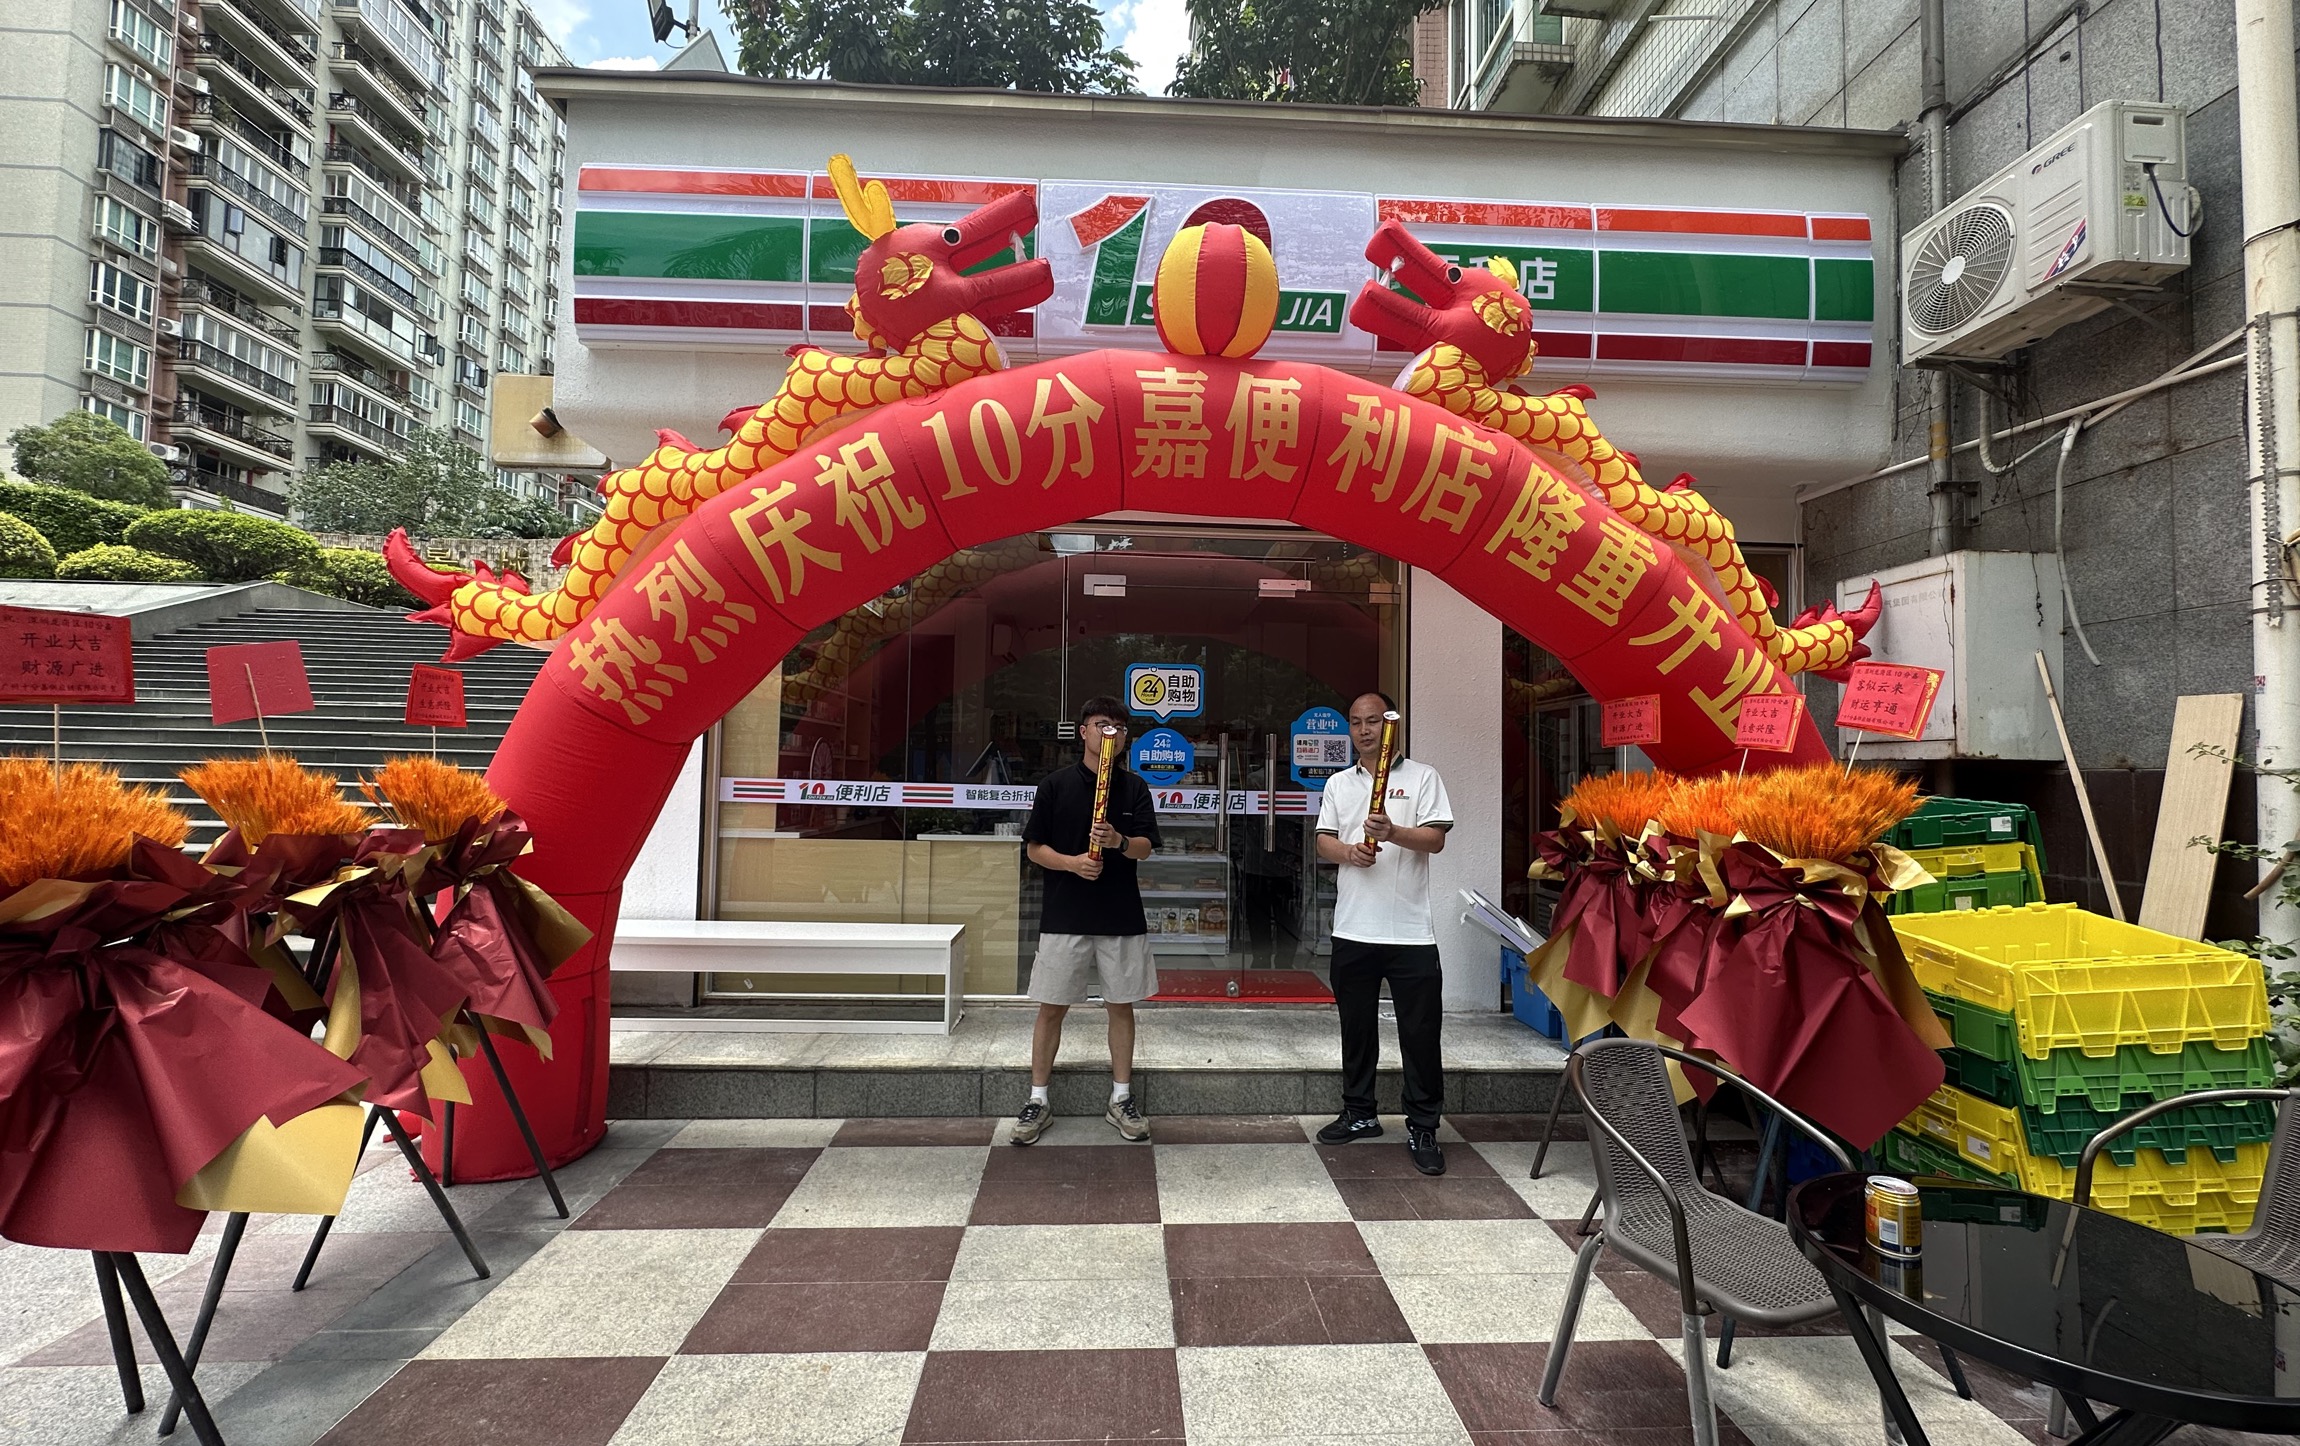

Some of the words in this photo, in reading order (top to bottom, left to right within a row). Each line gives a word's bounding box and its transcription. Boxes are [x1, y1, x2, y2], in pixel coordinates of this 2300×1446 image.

[2043, 142, 2076, 168] GREE
[1281, 297, 1333, 327] JIA
[568, 366, 1784, 744] 热烈庆祝10分嘉便利店隆重开业
[20, 632, 102, 652] 开业大吉
[21, 660, 105, 677] 财源广进
[1142, 677, 1159, 698] 24
[1168, 674, 1195, 688] 自助
[1856, 679, 1904, 695] 客似云来
[1167, 689, 1196, 703] 购物
[1612, 708, 1642, 718] 开业大吉
[1745, 707, 1779, 718] 开业大吉
[1850, 698, 1898, 715] 财运亨通
[1306, 719, 1338, 730] 营业中
[1741, 723, 1775, 734] 生意兴隆
[1140, 750, 1185, 762] 自助购物
[835, 783, 891, 802] 便利店
[965, 789, 1034, 802] 智能复合折扣
